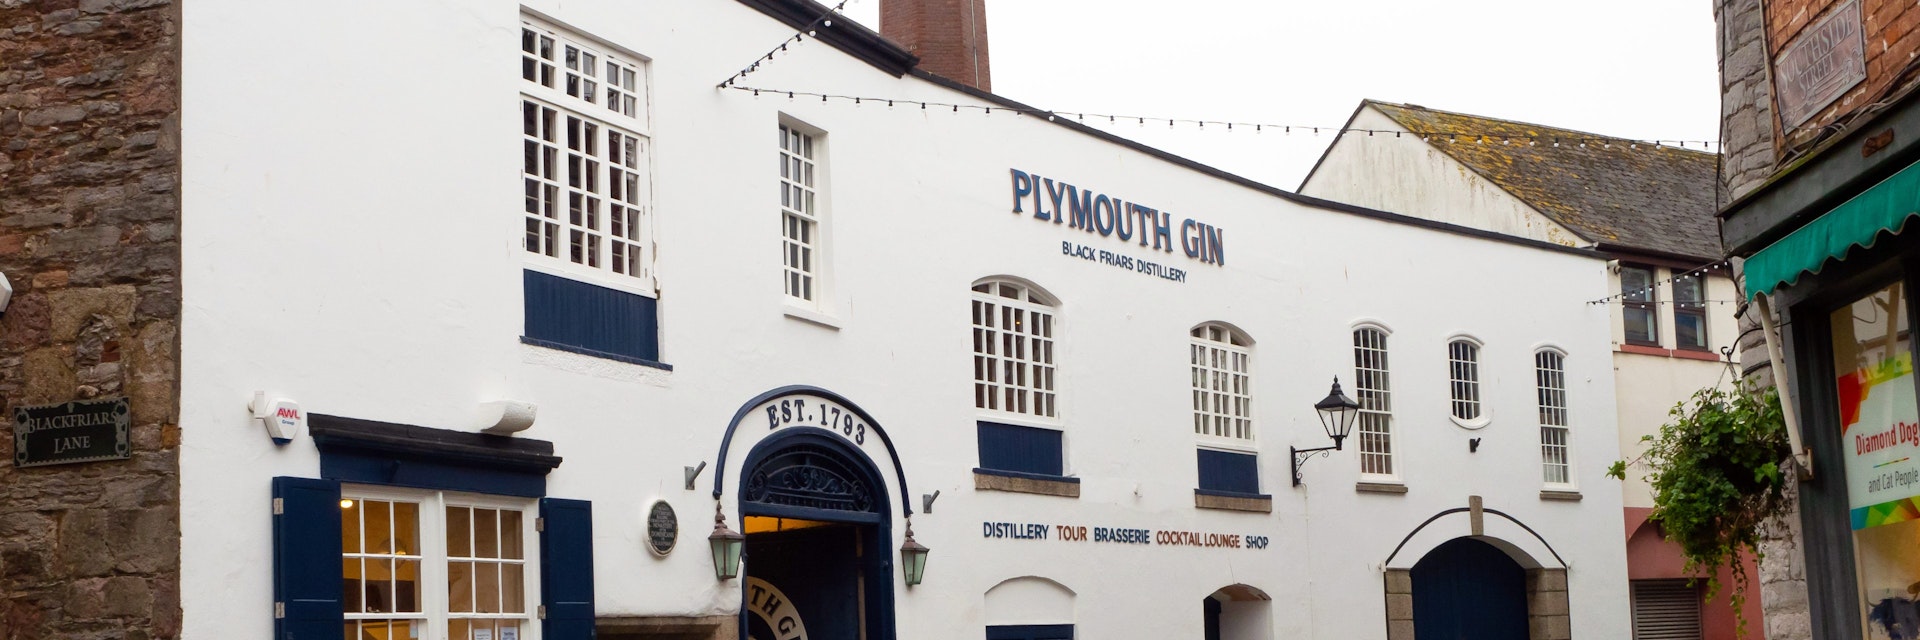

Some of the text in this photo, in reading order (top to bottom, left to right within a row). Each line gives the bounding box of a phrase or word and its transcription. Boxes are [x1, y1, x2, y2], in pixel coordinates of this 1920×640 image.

[1780, 9, 1854, 94] SOUTHSIDE
[1800, 53, 1834, 99] STREET
[1010, 167, 1225, 266] PLYMOUTH GIN
[1062, 241, 1187, 283] BLACK FRIARS DISTILLERY
[28, 411, 117, 434] BLACKFRIARS
[276, 407, 301, 420] AWL
[766, 399, 865, 445] EST. 1793
[54, 435, 91, 454] LANE
[1855, 423, 1897, 456] Diamond
[1868, 467, 1919, 493] and Cat People
[983, 521, 1269, 550] DISTILLERY TOUR BRASSERIE COCKTAIL LOUNGE SHOP
